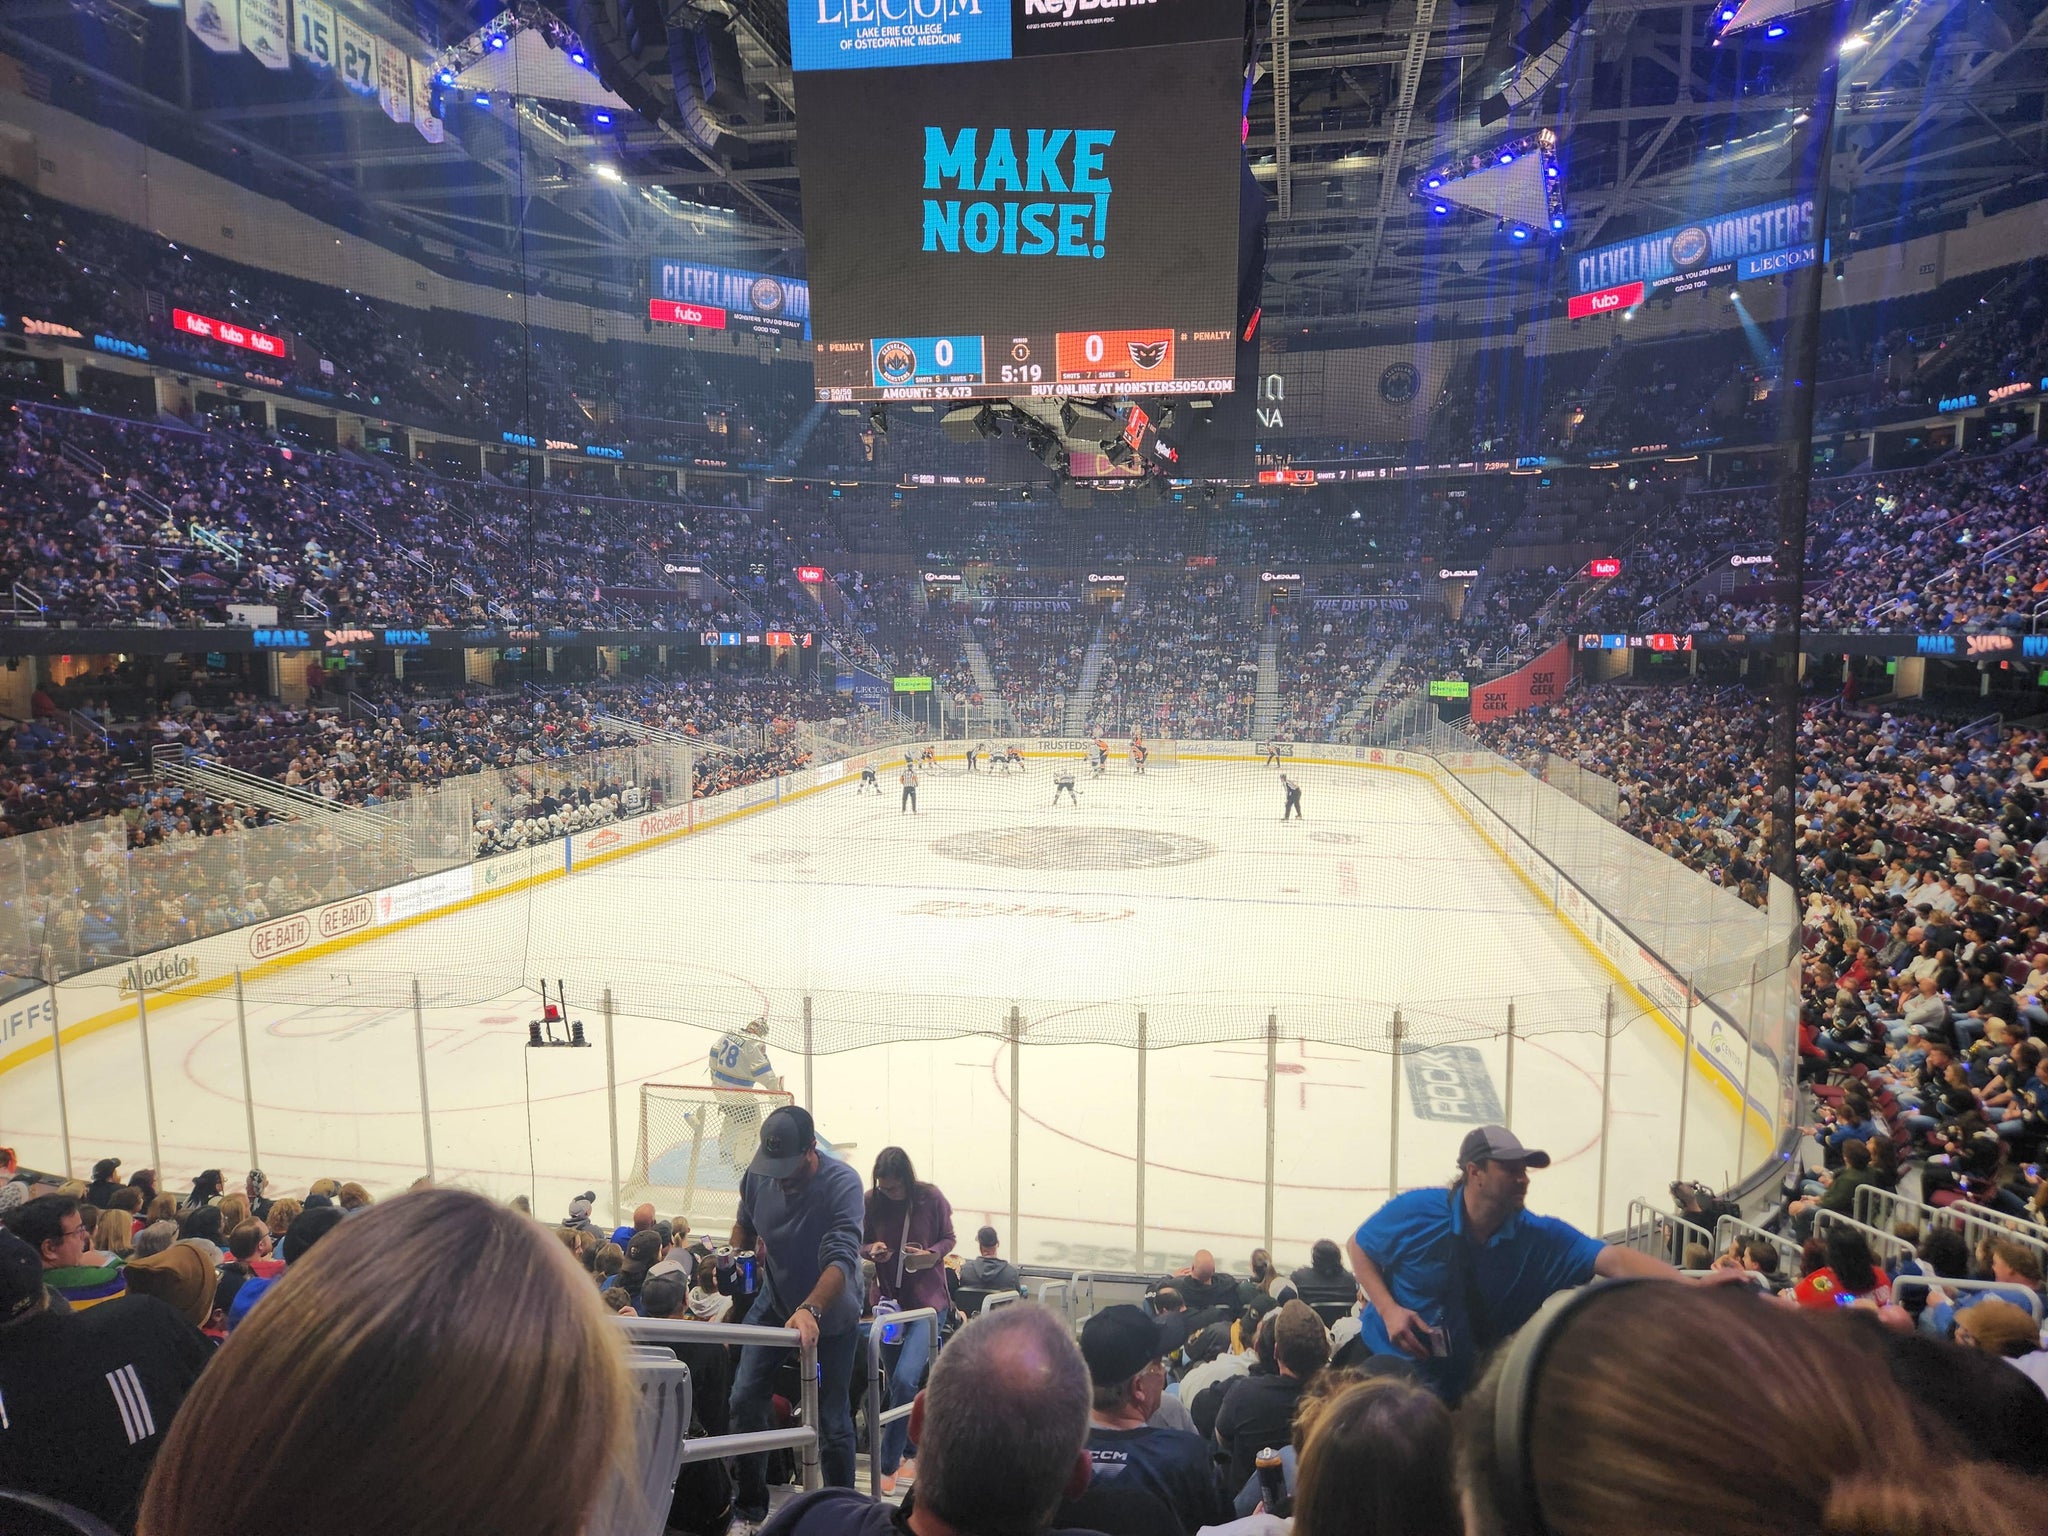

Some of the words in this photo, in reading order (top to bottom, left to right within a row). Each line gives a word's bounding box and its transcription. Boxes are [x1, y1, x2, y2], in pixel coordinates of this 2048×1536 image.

[302, 14, 329, 61] 15
[856, 27, 880, 39] LAKE
[881, 25, 901, 37] ERIE
[902, 23, 943, 36] COLLEGE
[840, 39, 853, 51] OF
[854, 35, 916, 50] OSTEOPATHIC
[918, 33, 963, 46] MEDICINE
[344, 41, 371, 88] 27
[923, 126, 1117, 194] MAKE
[922, 191, 1111, 260] NOISE!
[1579, 236, 1674, 293] CLEVELAND
[1705, 200, 1816, 261] MONSTERS
[1709, 263, 1732, 274] REALLY
[662, 264, 755, 313] CLEVELAND
[1592, 293, 1619, 310] fubo
[674, 306, 703, 323] fubo
[1193, 331, 1232, 341] PENALTY
[829, 343, 865, 352] PENALTY
[935, 339, 954, 367] 0
[1085, 334, 1104, 362] 0
[935, 375, 941, 383] 5
[1001, 364, 1042, 383] 5:19
[883, 388, 932, 399] AMOUNT:
[935, 386, 973, 398] $4,473
[1031, 384, 1054, 396] BUY
[1055, 383, 1097, 396] ONLINE
[1098, 383, 1114, 395] AT
[1114, 380, 1233, 394] MONSTERS5050.COM
[942, 476, 961, 484] TOTAL
[1316, 472, 1336, 480] SHOTS
[1339, 470, 1347, 480] 7
[1379, 468, 1386, 478] 5
[1532, 672, 1555, 684] SEAT
[1484, 692, 1507, 702] SEAT
[1530, 684, 1555, 696] GEEK
[1482, 702, 1508, 711] GEEK
[1038, 740, 1088, 750] TRUSTEDS
[650, 809, 685, 835] Rocket
[718, 1039, 740, 1069] 28
[1089, 1450, 1129, 1461] CCM
